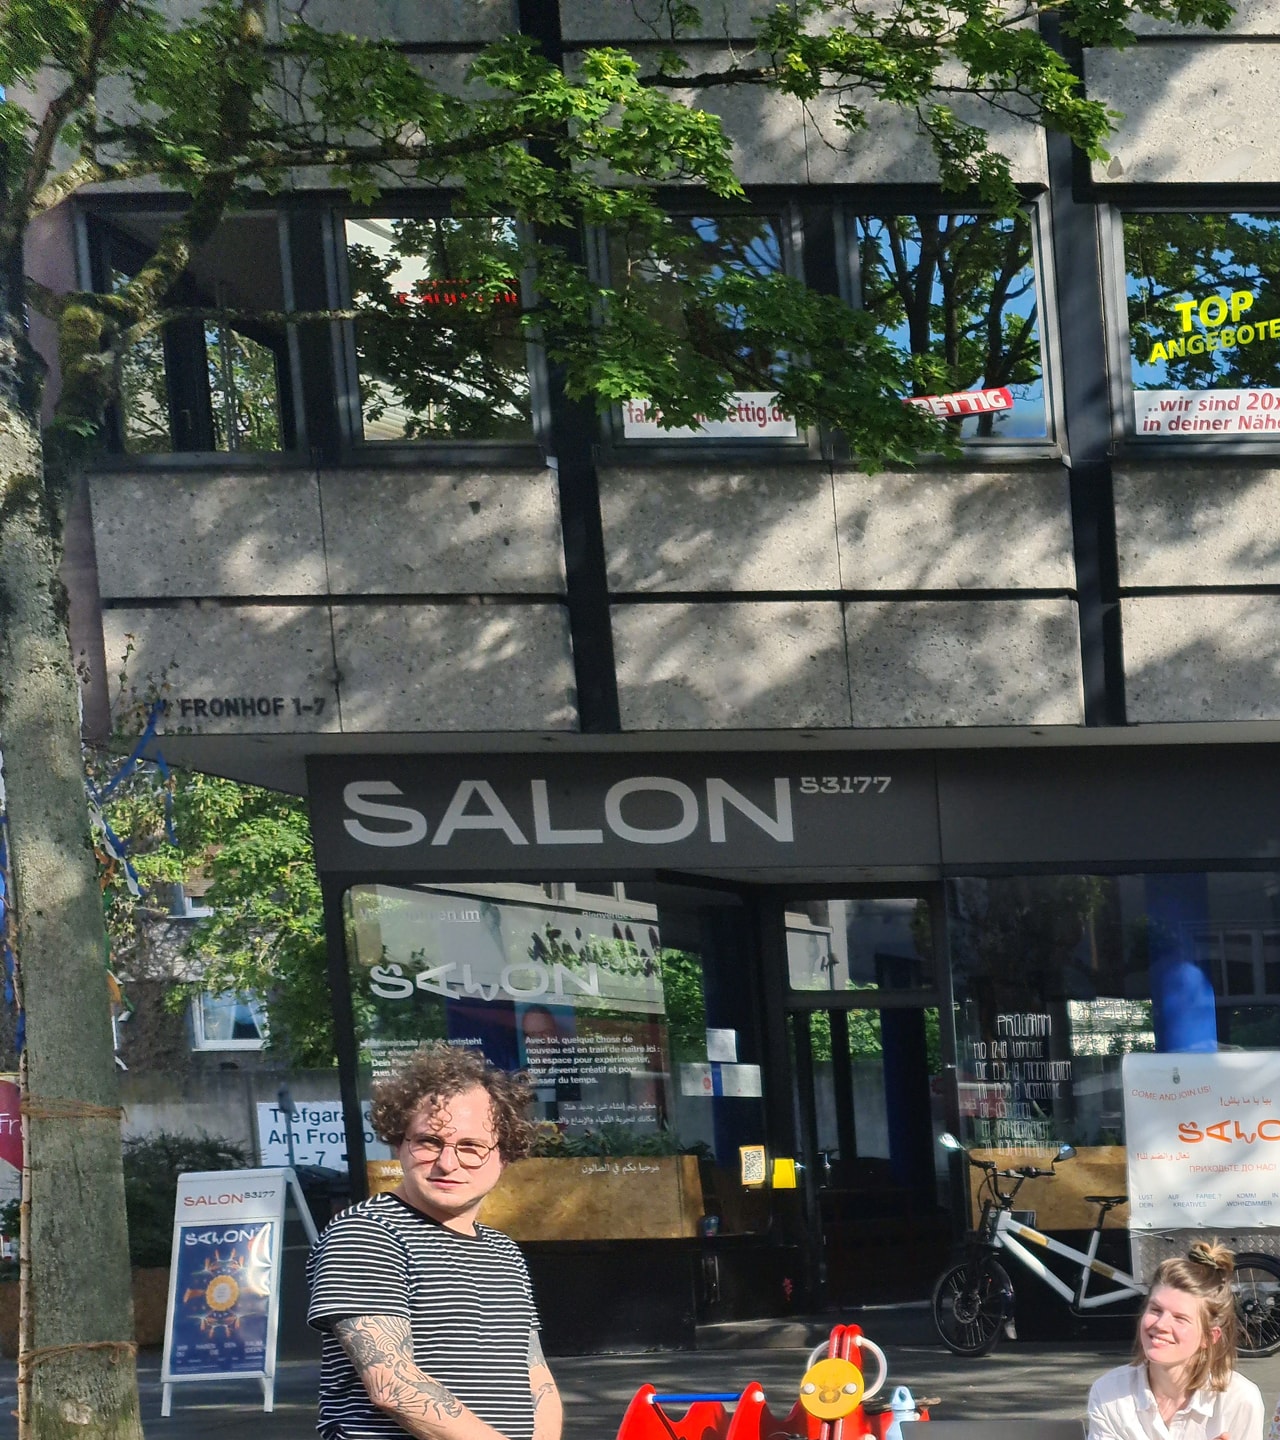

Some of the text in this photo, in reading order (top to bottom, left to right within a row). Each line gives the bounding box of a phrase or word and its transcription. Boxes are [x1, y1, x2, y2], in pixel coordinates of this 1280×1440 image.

[1174, 290, 1254, 334] TOP
[1198, 396, 1240, 413] sind
[1143, 416, 1161, 432] in
[1167, 415, 1232, 432] deiner
[180, 697, 284, 717] FRONHOF
[292, 697, 326, 716] 1-7
[342, 776, 892, 848] SALON 53177
[370, 962, 600, 1001] SALON
[526, 1036, 545, 1045] Avec
[562, 1036, 594, 1046] quelque
[623, 1035, 632, 1043] de
[526, 1046, 564, 1054] nouveau
[527, 1056, 540, 1065] ton
[542, 1056, 571, 1066] espace
[574, 1056, 593, 1065] pour
[547, 1066, 578, 1075] devenir
[580, 1065, 606, 1074] créatif
[609, 1065, 618, 1074] et
[558, 1076, 569, 1084] du
[1132, 1085, 1212, 1101] COME AND JOIN US!
[268, 1129, 300, 1144] Am
[183, 1193, 244, 1207] SALON
[185, 1229, 254, 1246] SALON
